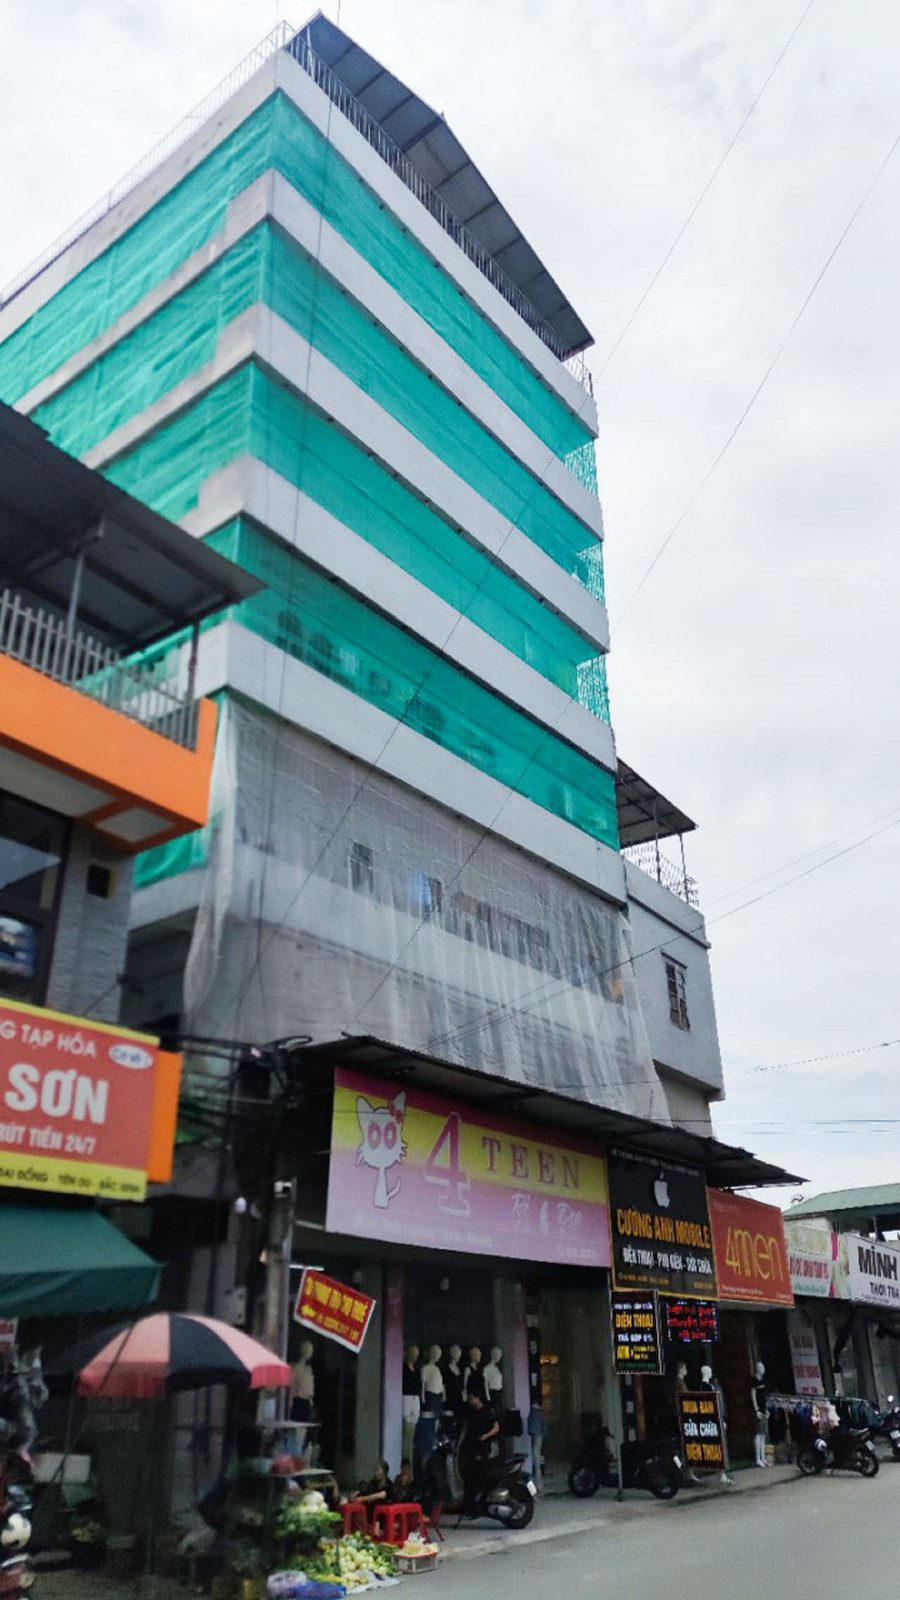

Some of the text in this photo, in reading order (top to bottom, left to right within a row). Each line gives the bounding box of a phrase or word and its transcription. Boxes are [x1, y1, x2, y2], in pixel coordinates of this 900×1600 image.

[0, 1019, 97, 1058] G TẠP HÓA
[4, 1063, 109, 1125] SƠN
[424, 1111, 580, 1203] 4 TEEN
[655, 1215, 675, 1243] ANH
[675, 1220, 711, 1249] MOBILE
[725, 1226, 784, 1281] 4men
